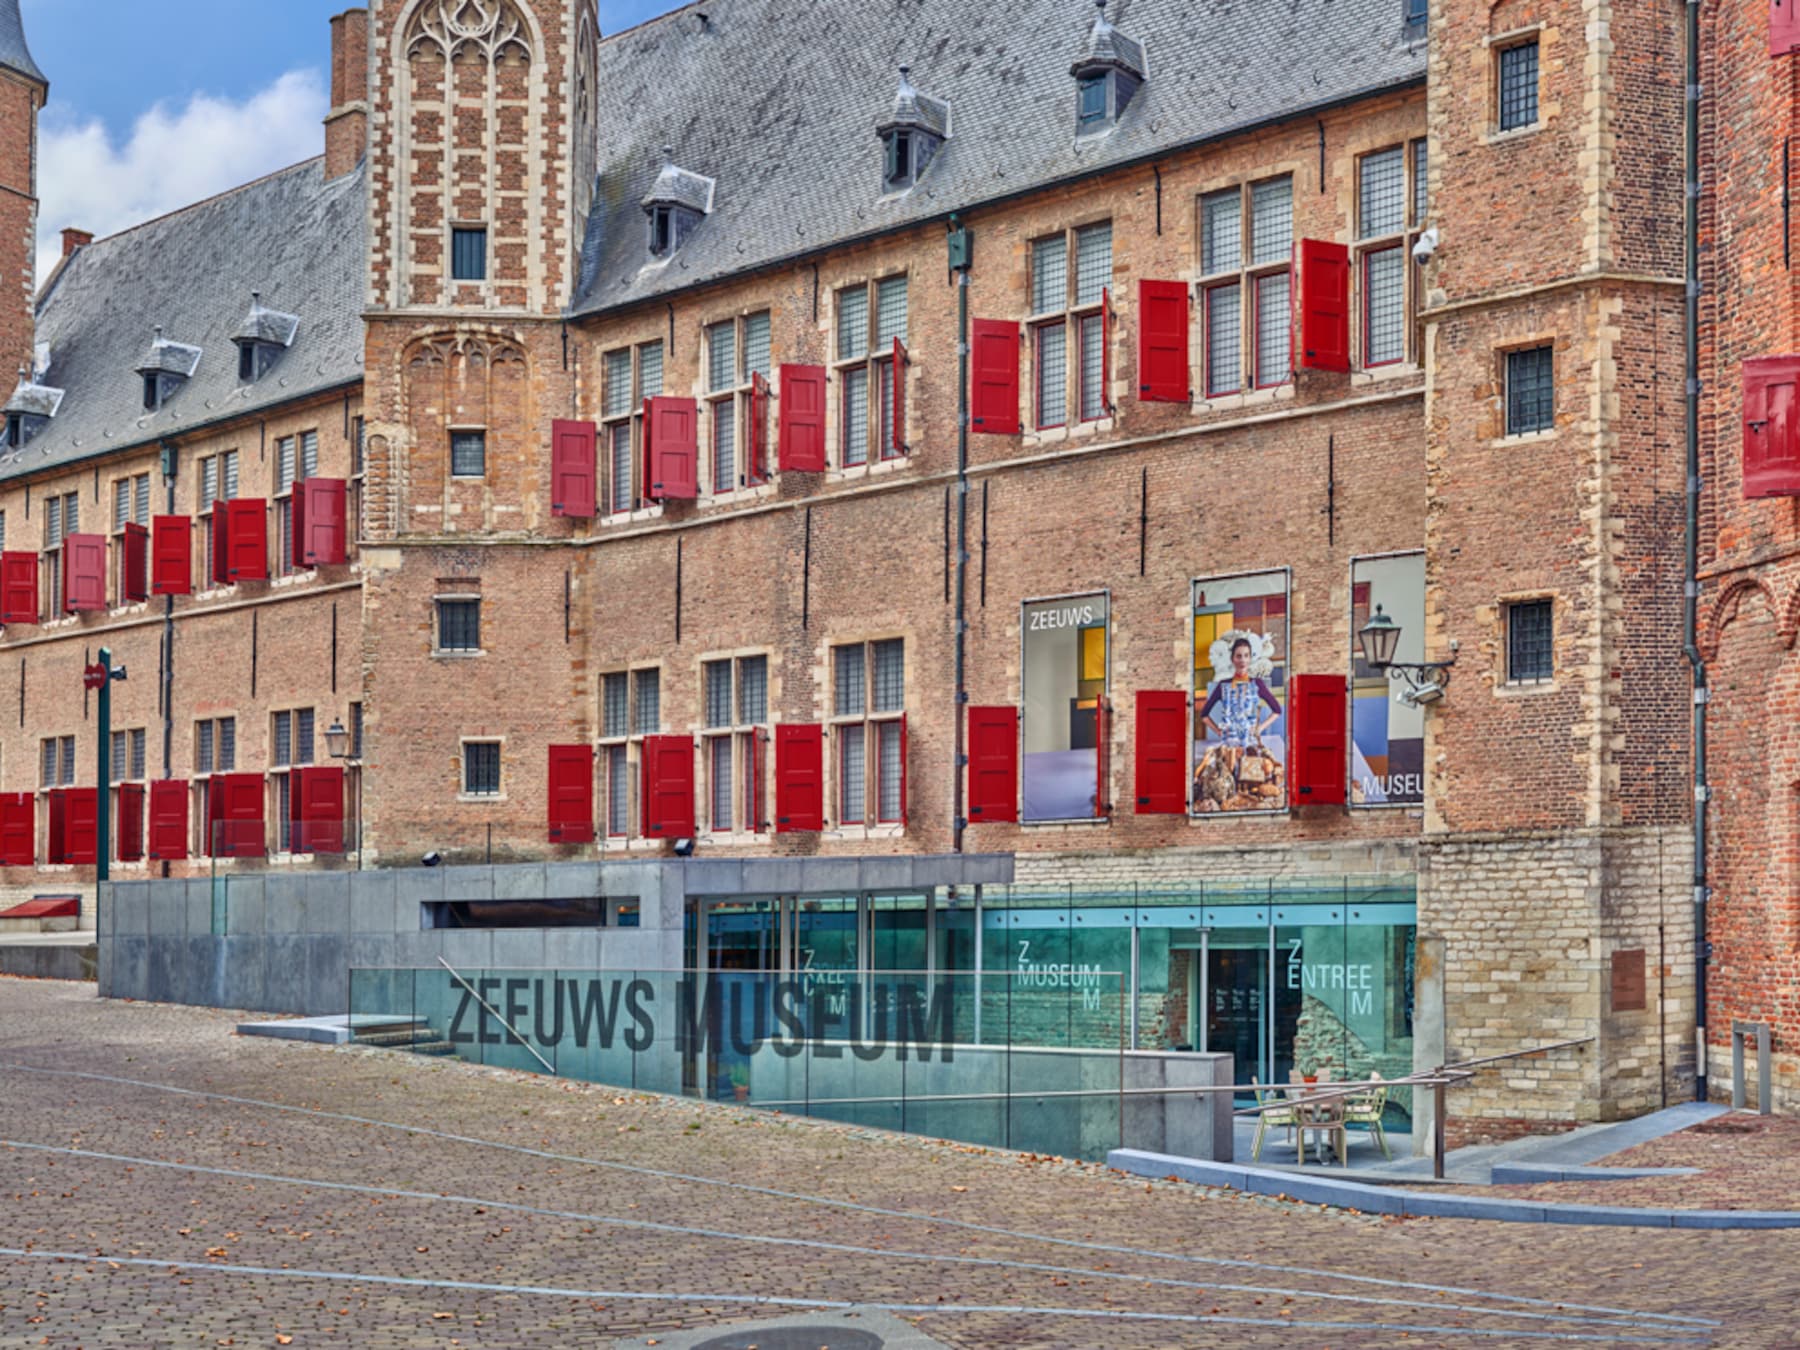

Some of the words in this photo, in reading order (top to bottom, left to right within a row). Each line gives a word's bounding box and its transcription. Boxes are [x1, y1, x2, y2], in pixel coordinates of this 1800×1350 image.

[1030, 606, 1093, 631] ZEEUWS
[1363, 773, 1424, 795] MUSEU
[803, 949, 815, 972] Z
[1018, 940, 1030, 962] Z
[1288, 939, 1302, 963] Z
[1018, 964, 1100, 987] MUSEUM
[1287, 964, 1372, 989] ENTREE
[830, 995, 846, 1016] M
[1083, 988, 1100, 1010] M
[1352, 991, 1372, 1015] M
[449, 978, 655, 1051] ZEEUWS
[675, 981, 954, 1063] MUSEUM
